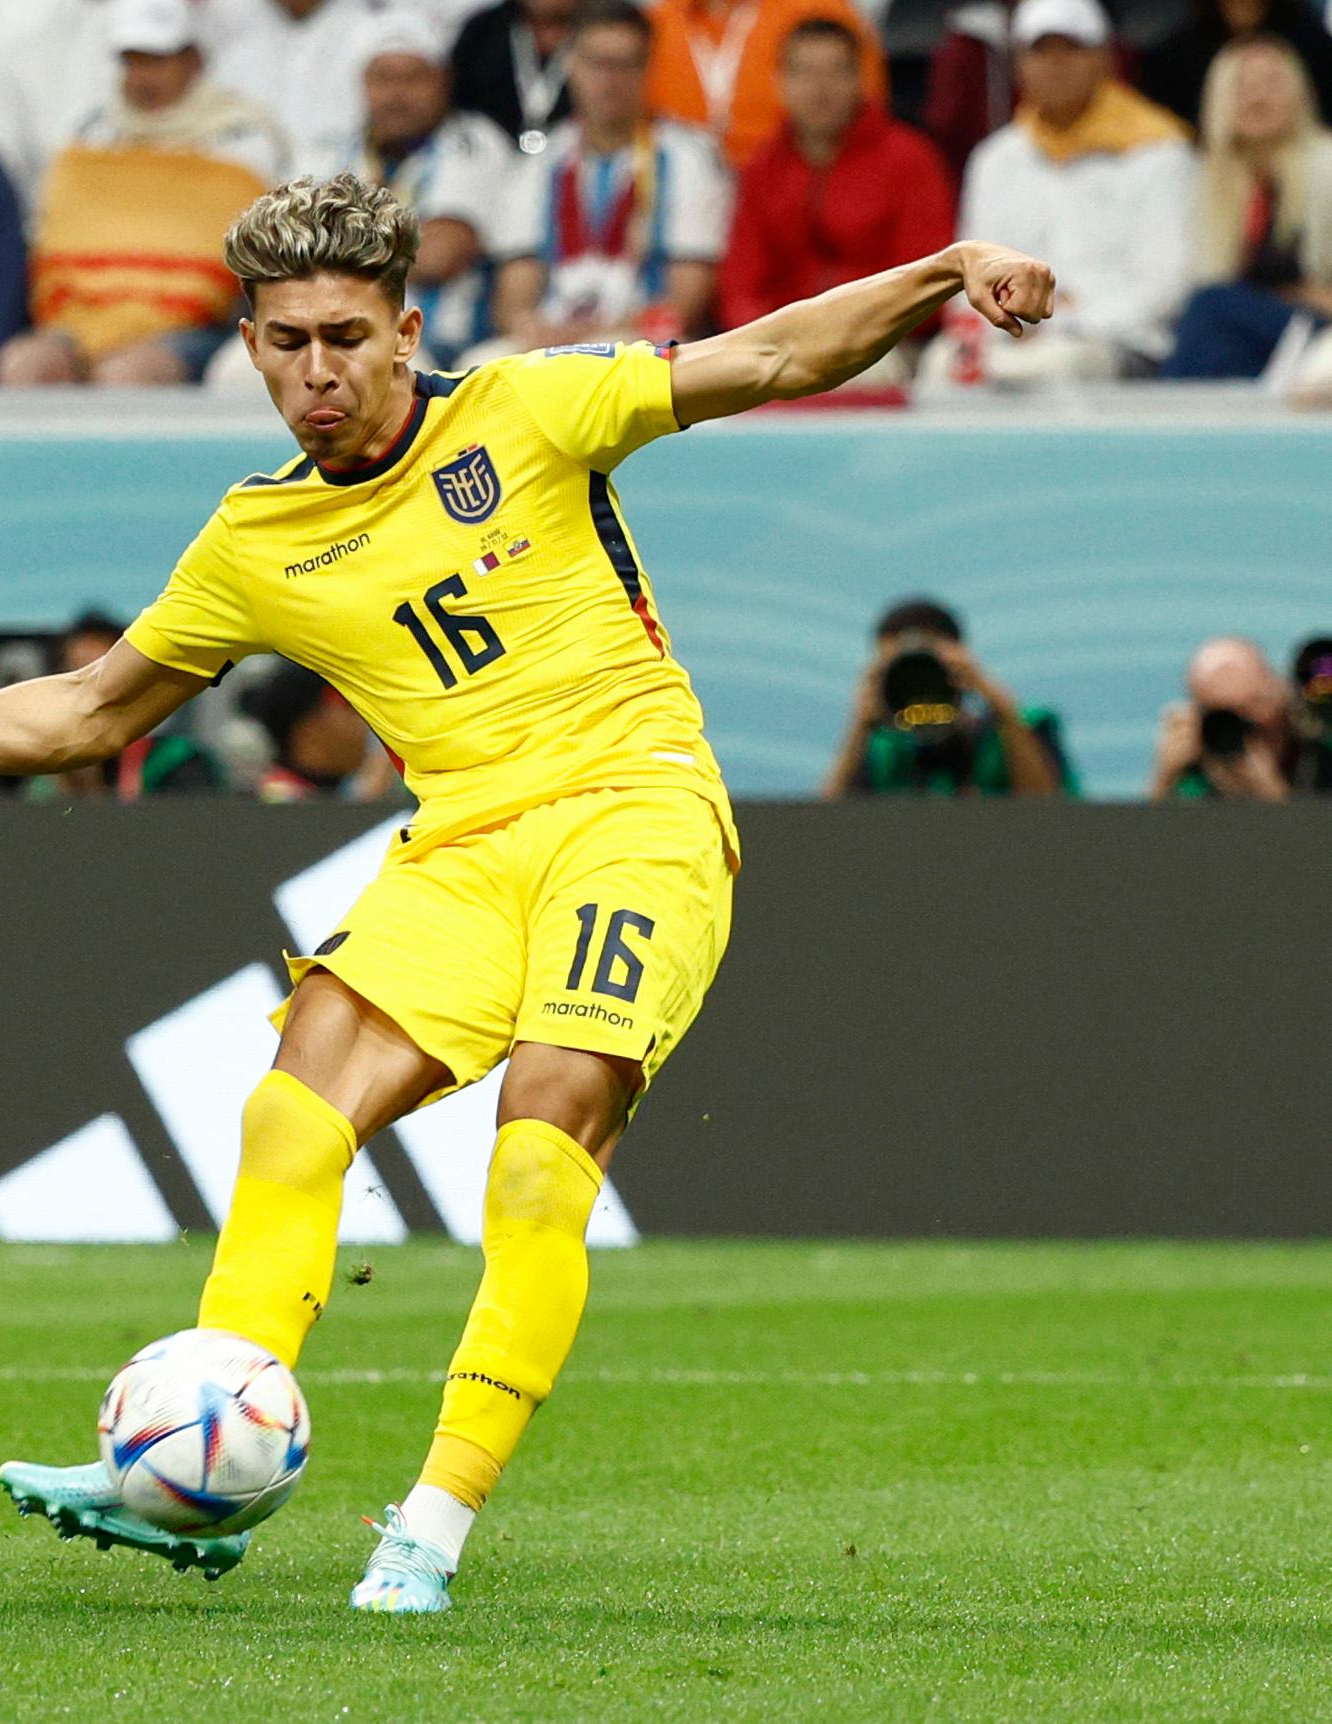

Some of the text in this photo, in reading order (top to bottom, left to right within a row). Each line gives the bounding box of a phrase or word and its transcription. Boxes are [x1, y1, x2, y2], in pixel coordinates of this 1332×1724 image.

[284, 533, 371, 579] marathon
[392, 572, 507, 690] 16
[565, 903, 656, 1004] 16
[541, 1002, 634, 1030] marathon
[448, 1372, 520, 1400] rathon
